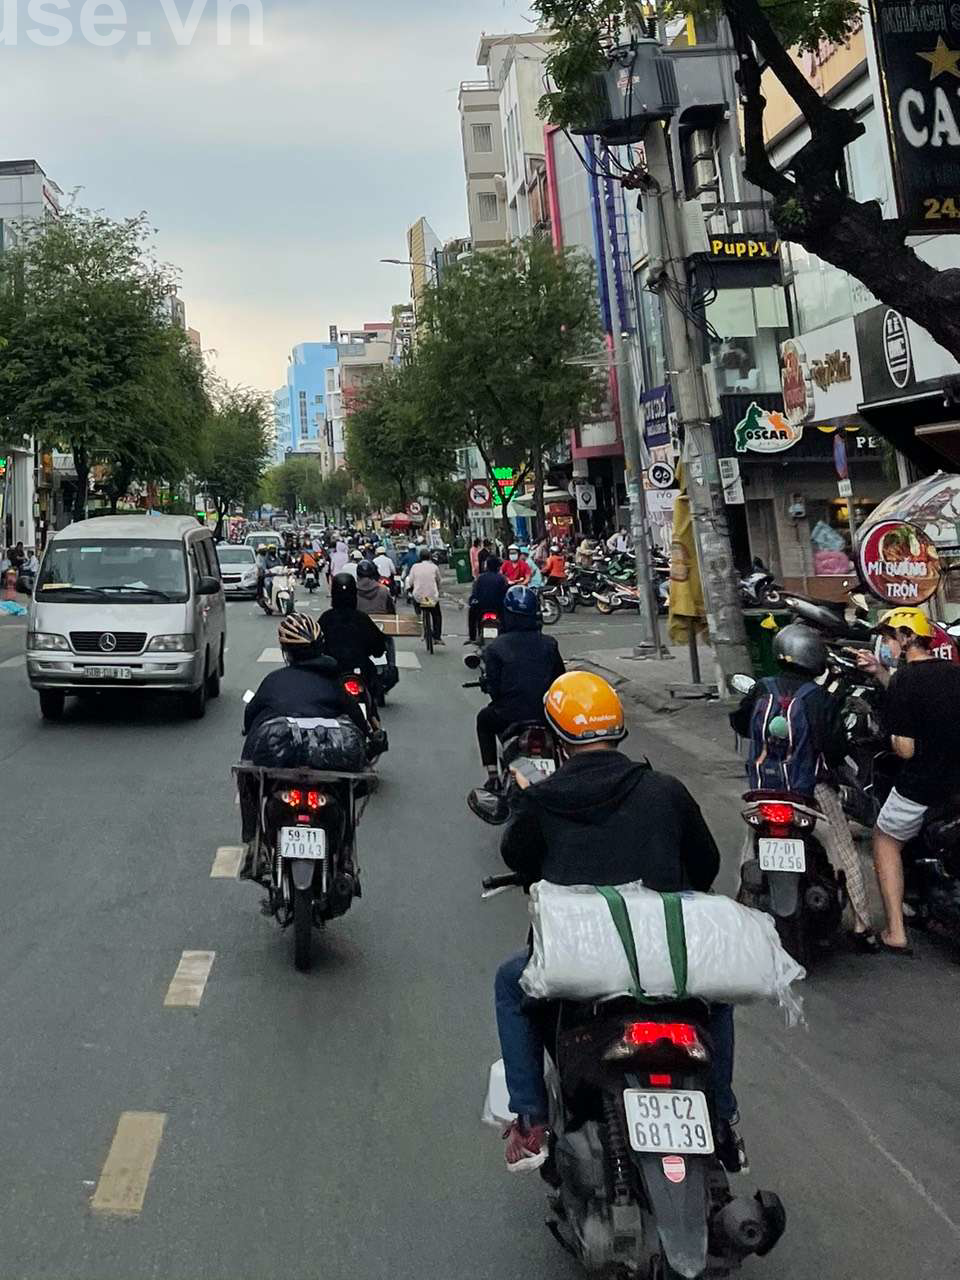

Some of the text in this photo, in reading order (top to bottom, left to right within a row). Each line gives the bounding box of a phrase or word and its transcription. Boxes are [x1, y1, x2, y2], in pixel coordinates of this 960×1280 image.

[899, 86, 960, 148] CA
[712, 240, 771, 257] Puppy
[746, 429, 788, 440] OSCAR
[637, 1094, 696, 1121] 59-C2
[635, 1122, 707, 1148] 681.39
